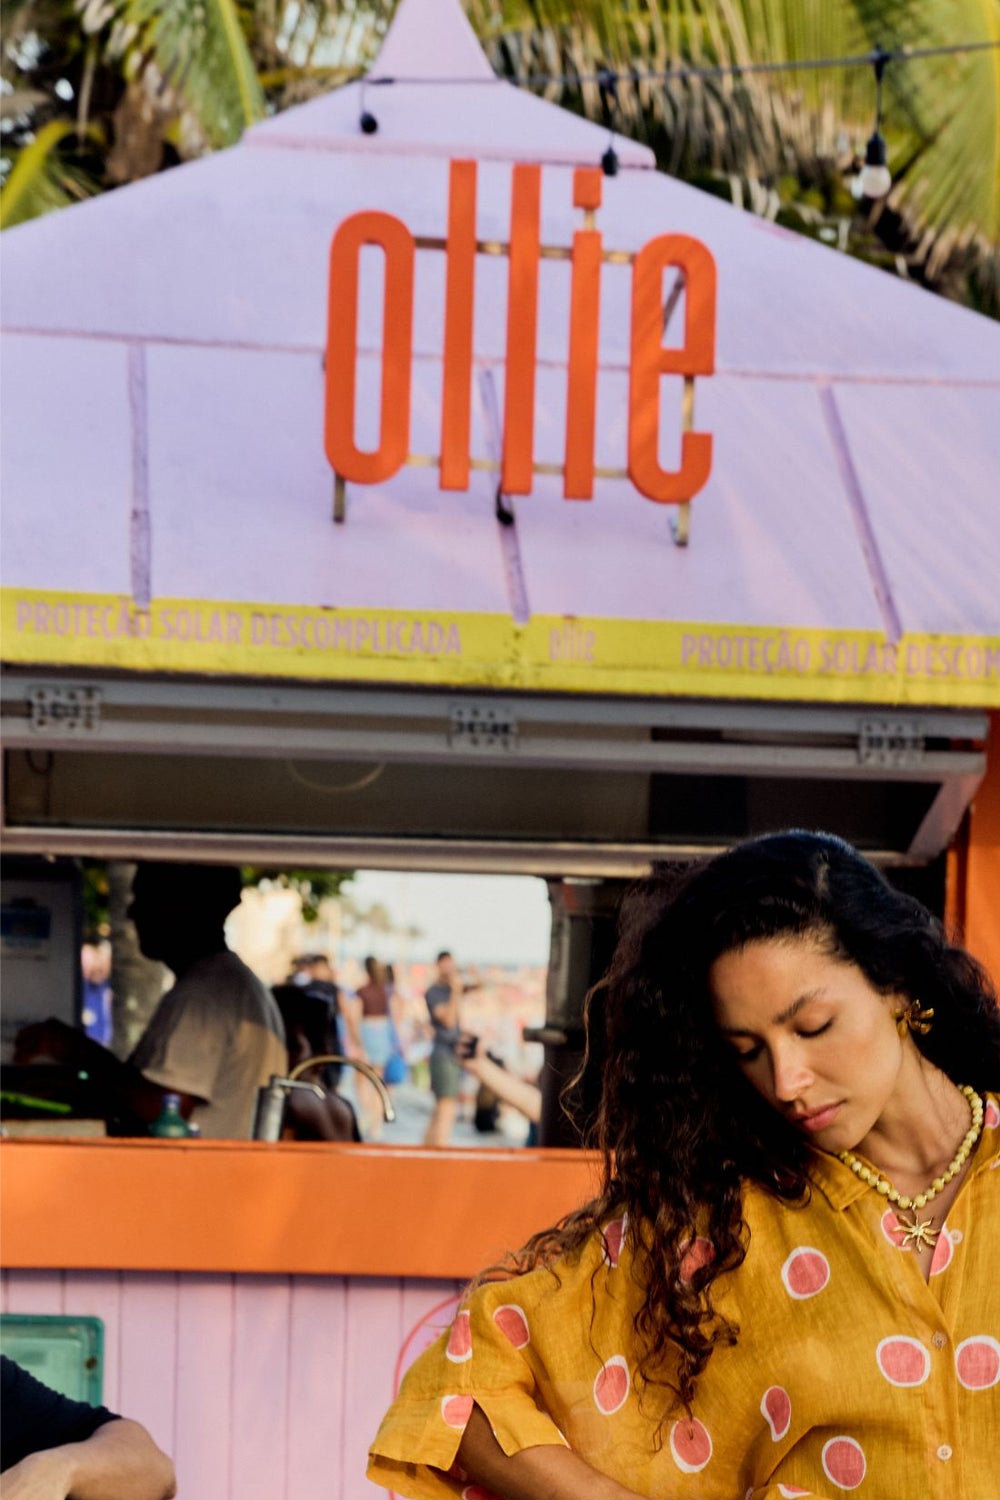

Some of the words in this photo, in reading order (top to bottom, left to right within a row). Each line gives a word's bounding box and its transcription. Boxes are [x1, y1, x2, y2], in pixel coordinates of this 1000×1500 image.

[323, 157, 717, 505] ollie
[159, 608, 243, 644] SOLAR
[252, 612, 463, 655] DESCOMPLICADA
[680, 632, 811, 674] PROTEÇÃO
[819, 639, 896, 676] SOLAR
